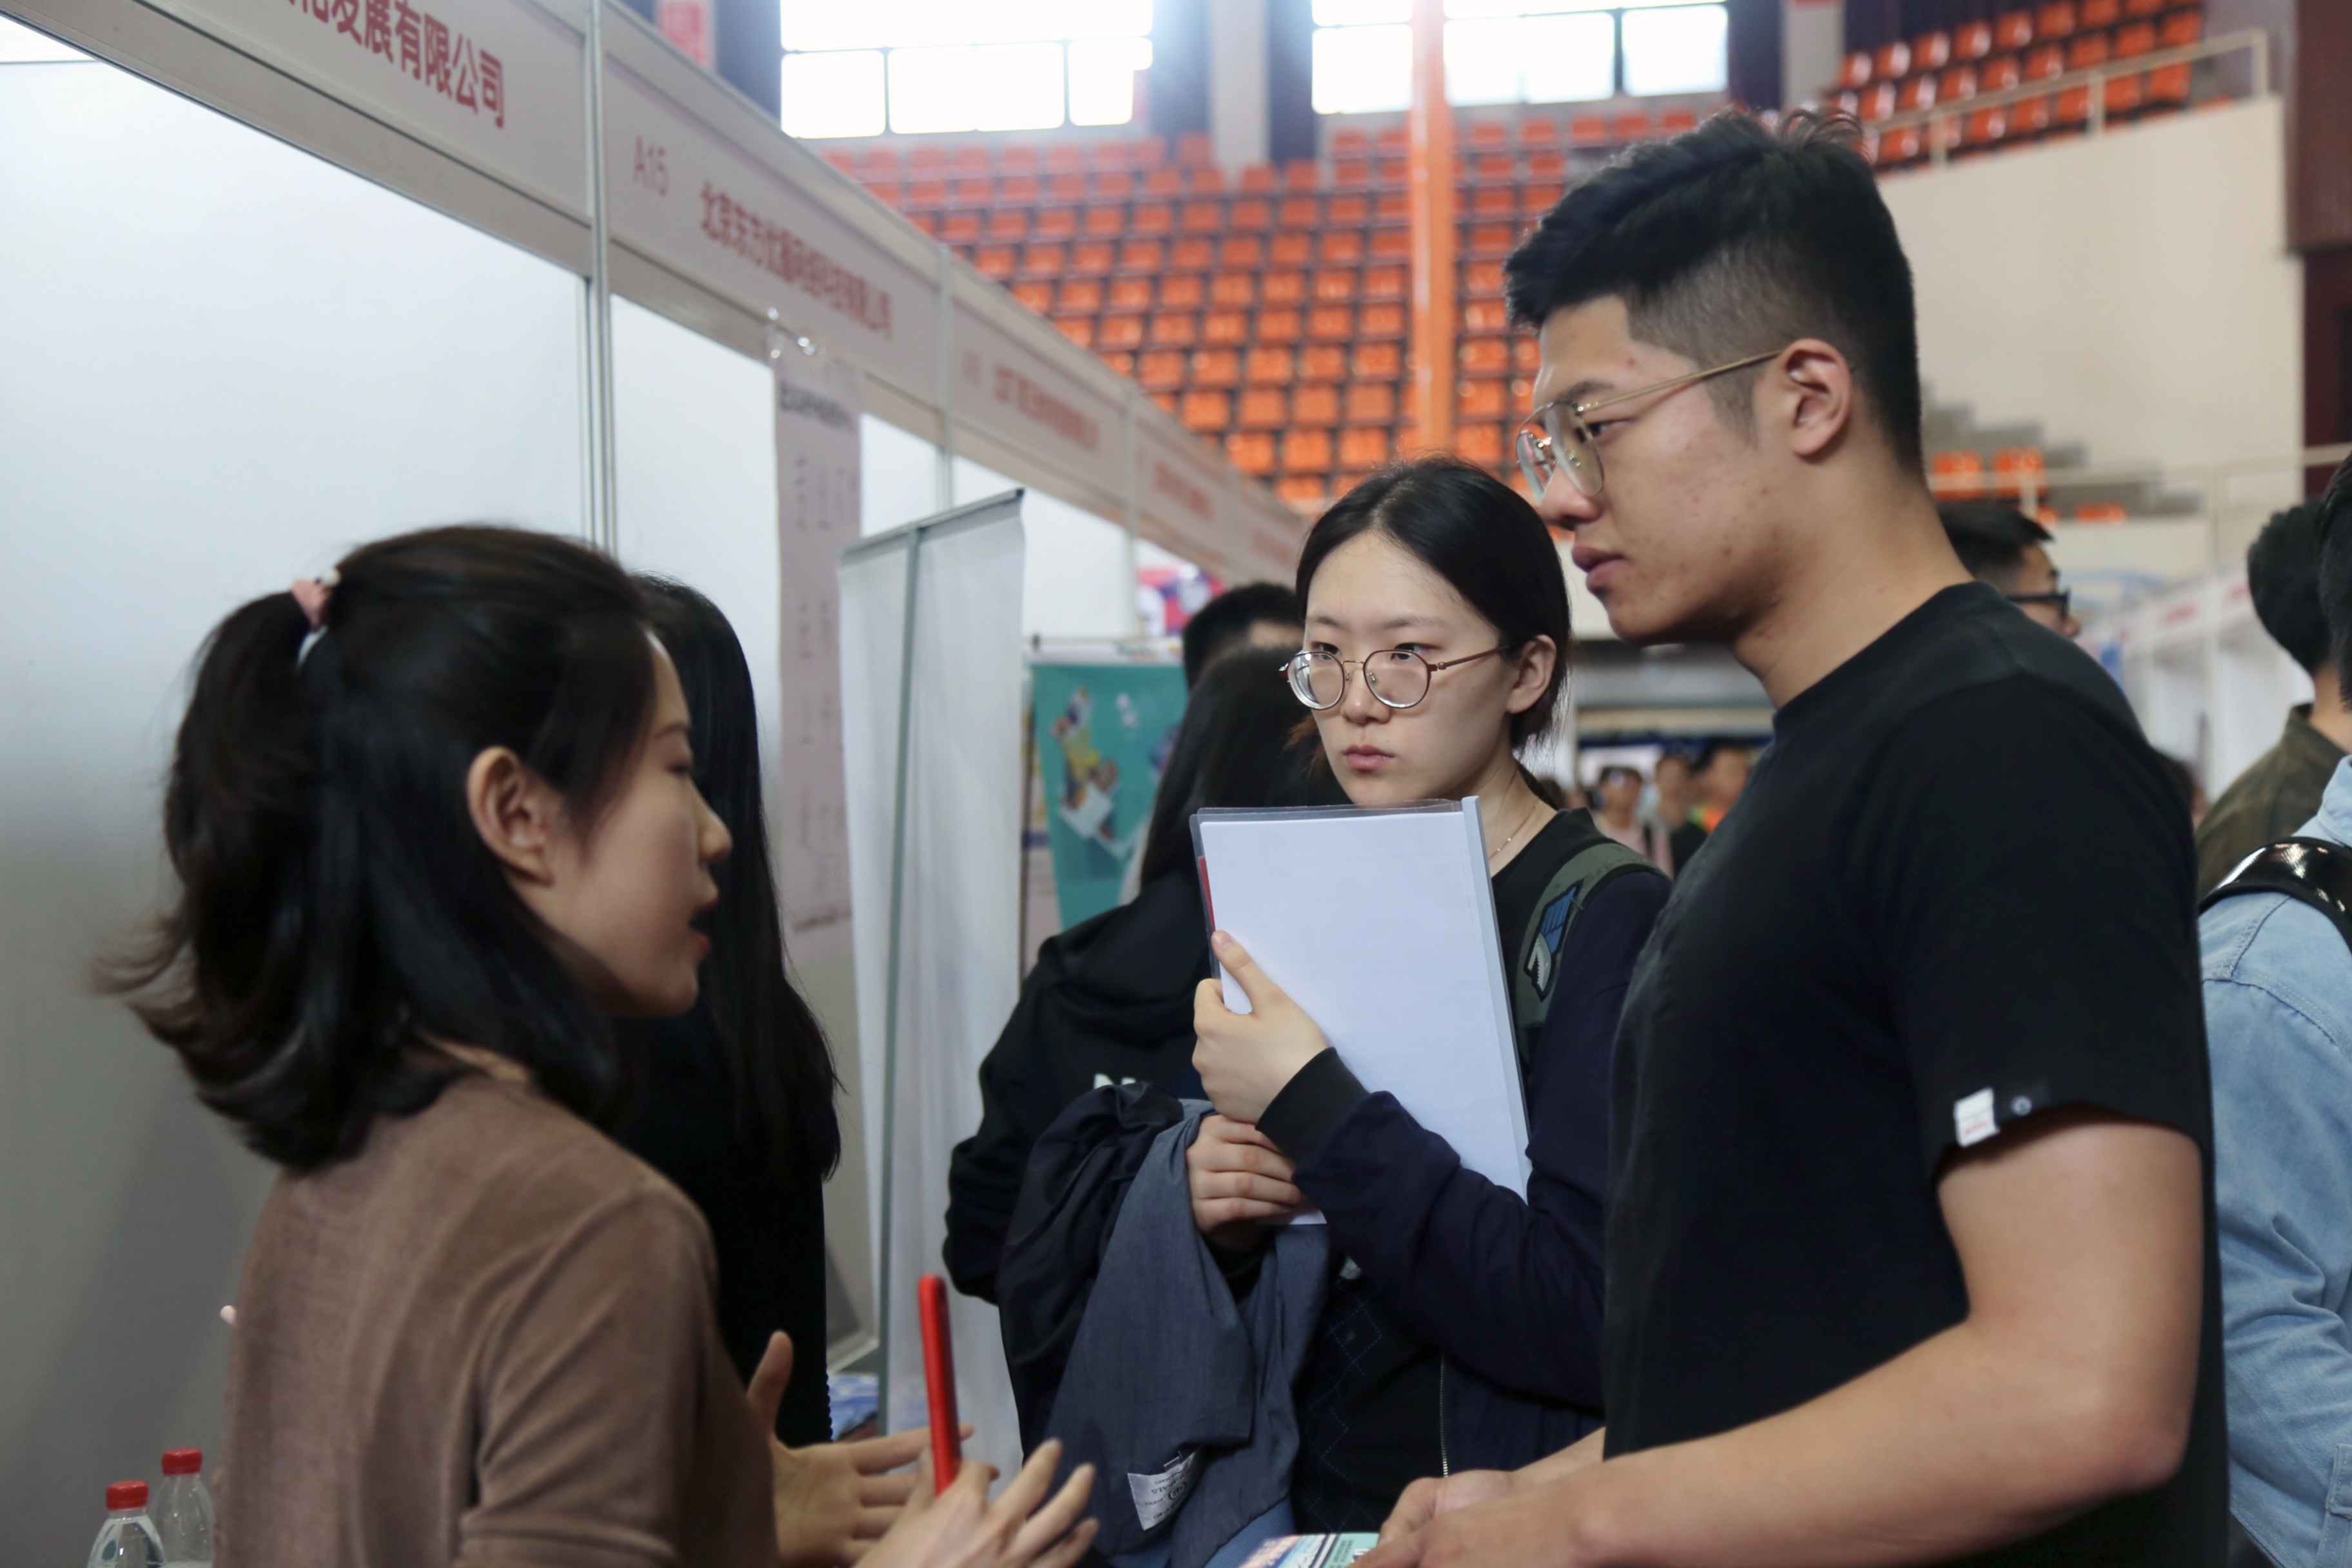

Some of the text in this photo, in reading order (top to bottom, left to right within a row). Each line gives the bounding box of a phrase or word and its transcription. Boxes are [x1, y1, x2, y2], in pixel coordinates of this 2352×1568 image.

[289, 0, 504, 128] 发展有限公司
[632, 135, 669, 197] A15
